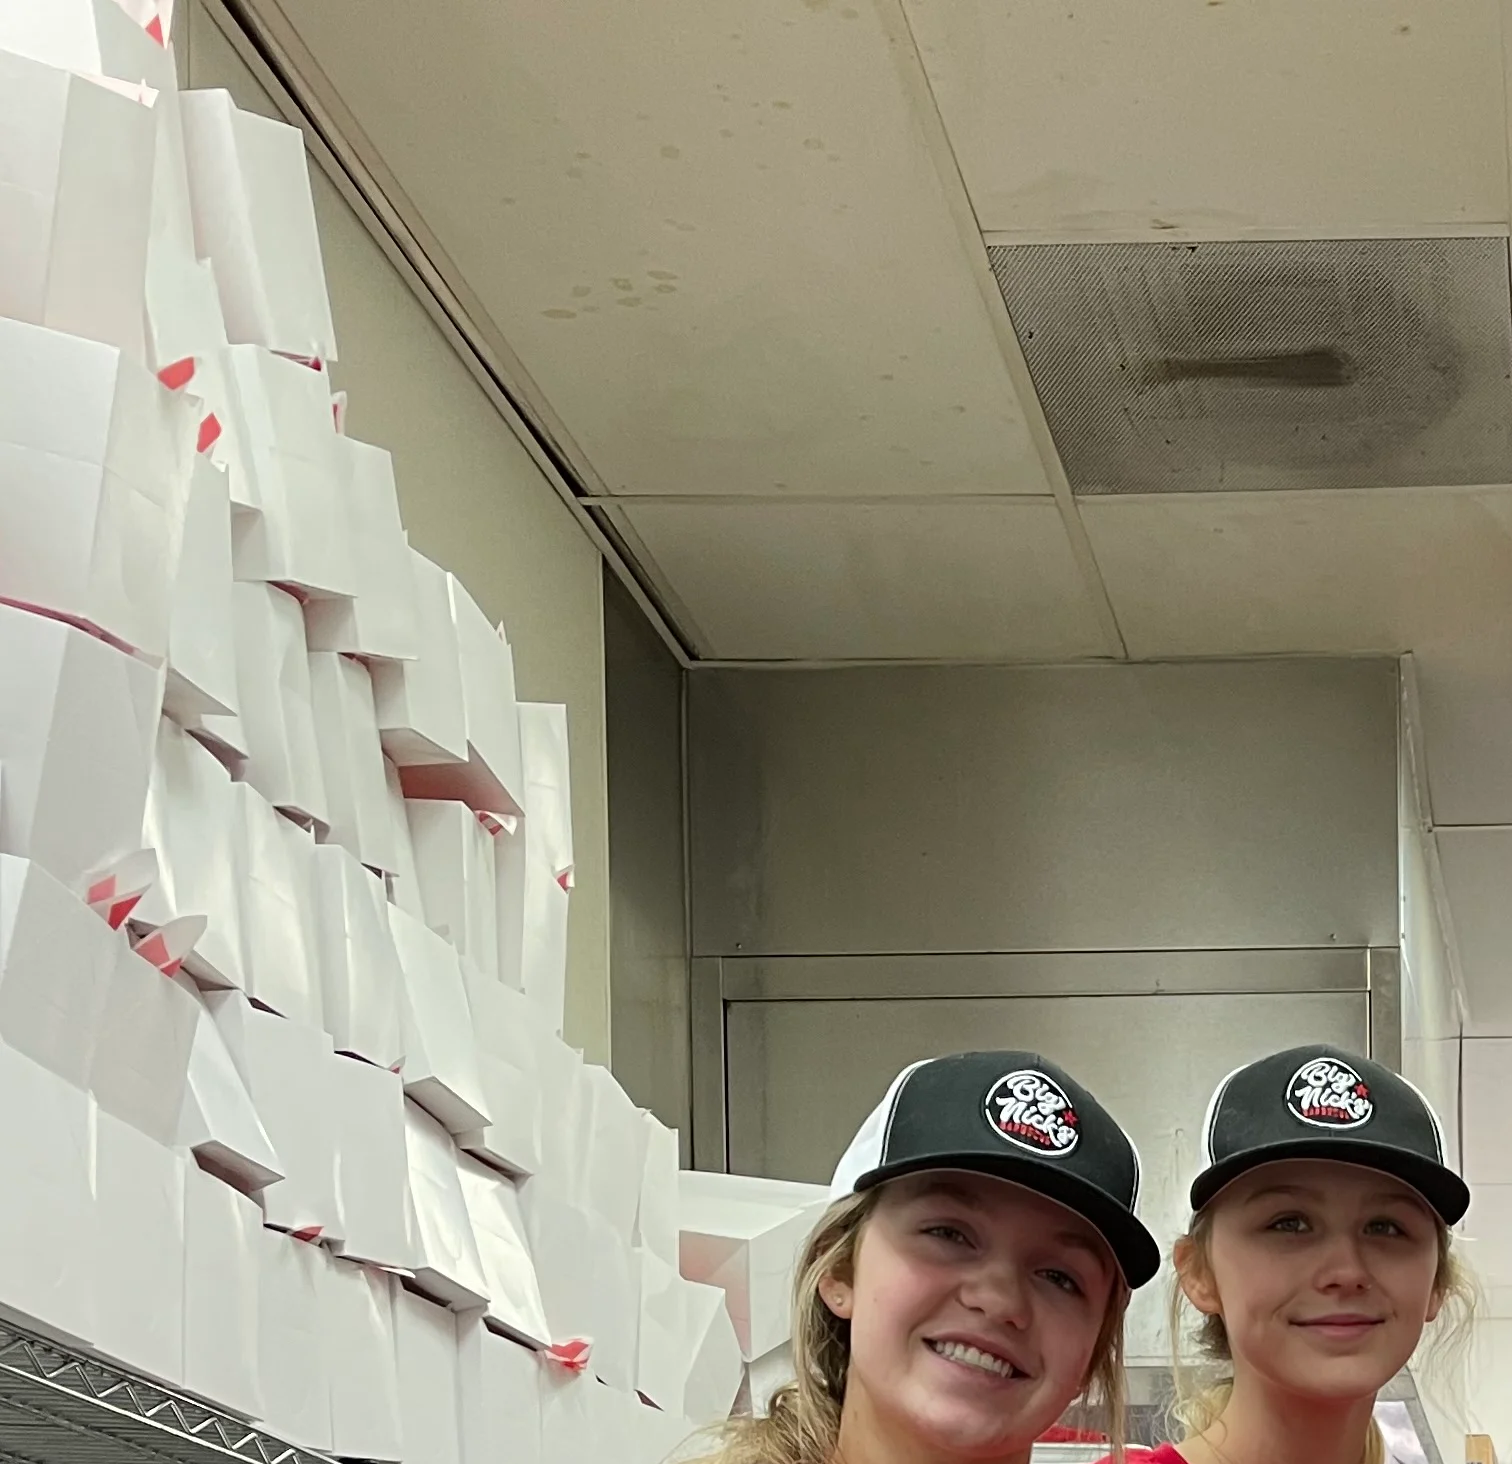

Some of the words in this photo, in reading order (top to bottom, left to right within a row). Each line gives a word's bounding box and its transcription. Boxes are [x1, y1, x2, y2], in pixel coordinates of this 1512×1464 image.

[1006, 1075, 1067, 1116] Big
[1301, 1062, 1357, 1094] Big
[1294, 1085, 1370, 1119] Nick's
[995, 1097, 1076, 1148] Nick's
